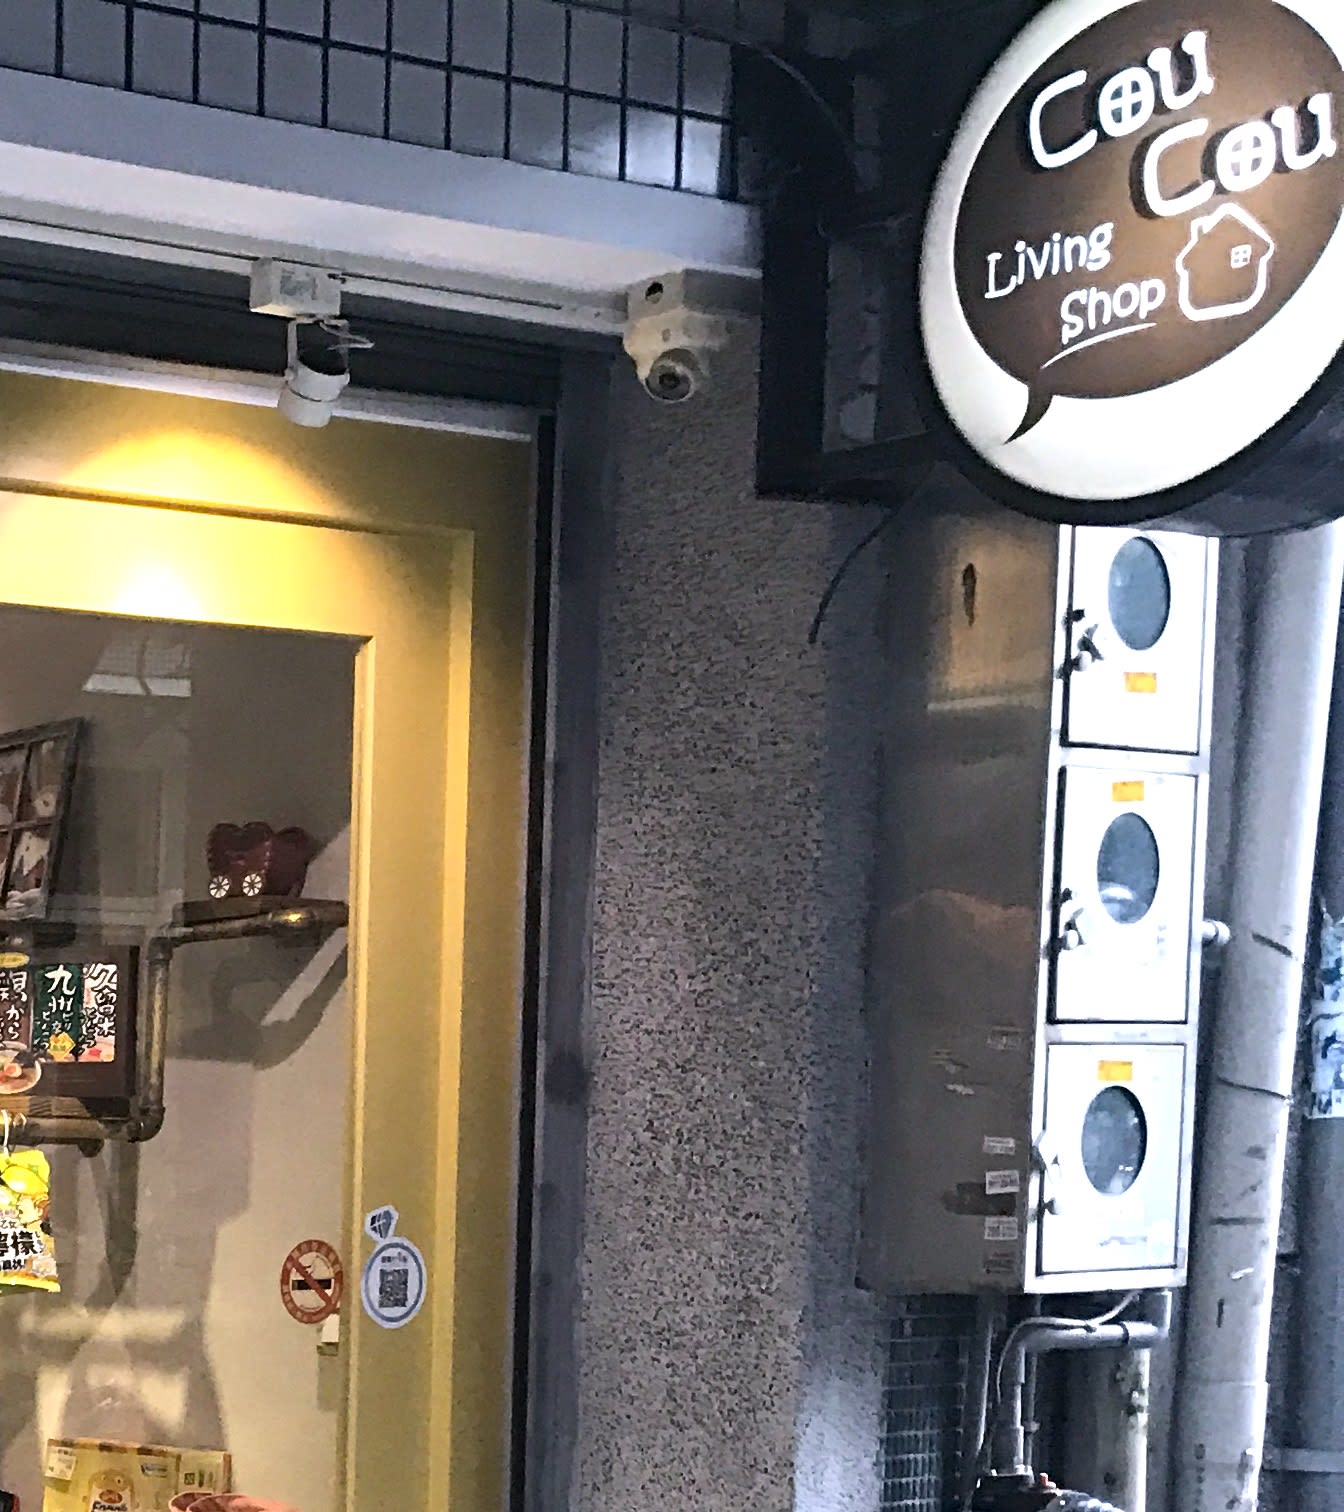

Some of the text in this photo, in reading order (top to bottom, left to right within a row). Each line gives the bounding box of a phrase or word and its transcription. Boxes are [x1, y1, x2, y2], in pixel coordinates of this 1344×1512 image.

[1029, 31, 1214, 169] Cou
[1143, 92, 1337, 217] Cou
[984, 222, 1114, 299] Living
[1060, 278, 1166, 345] Shop
